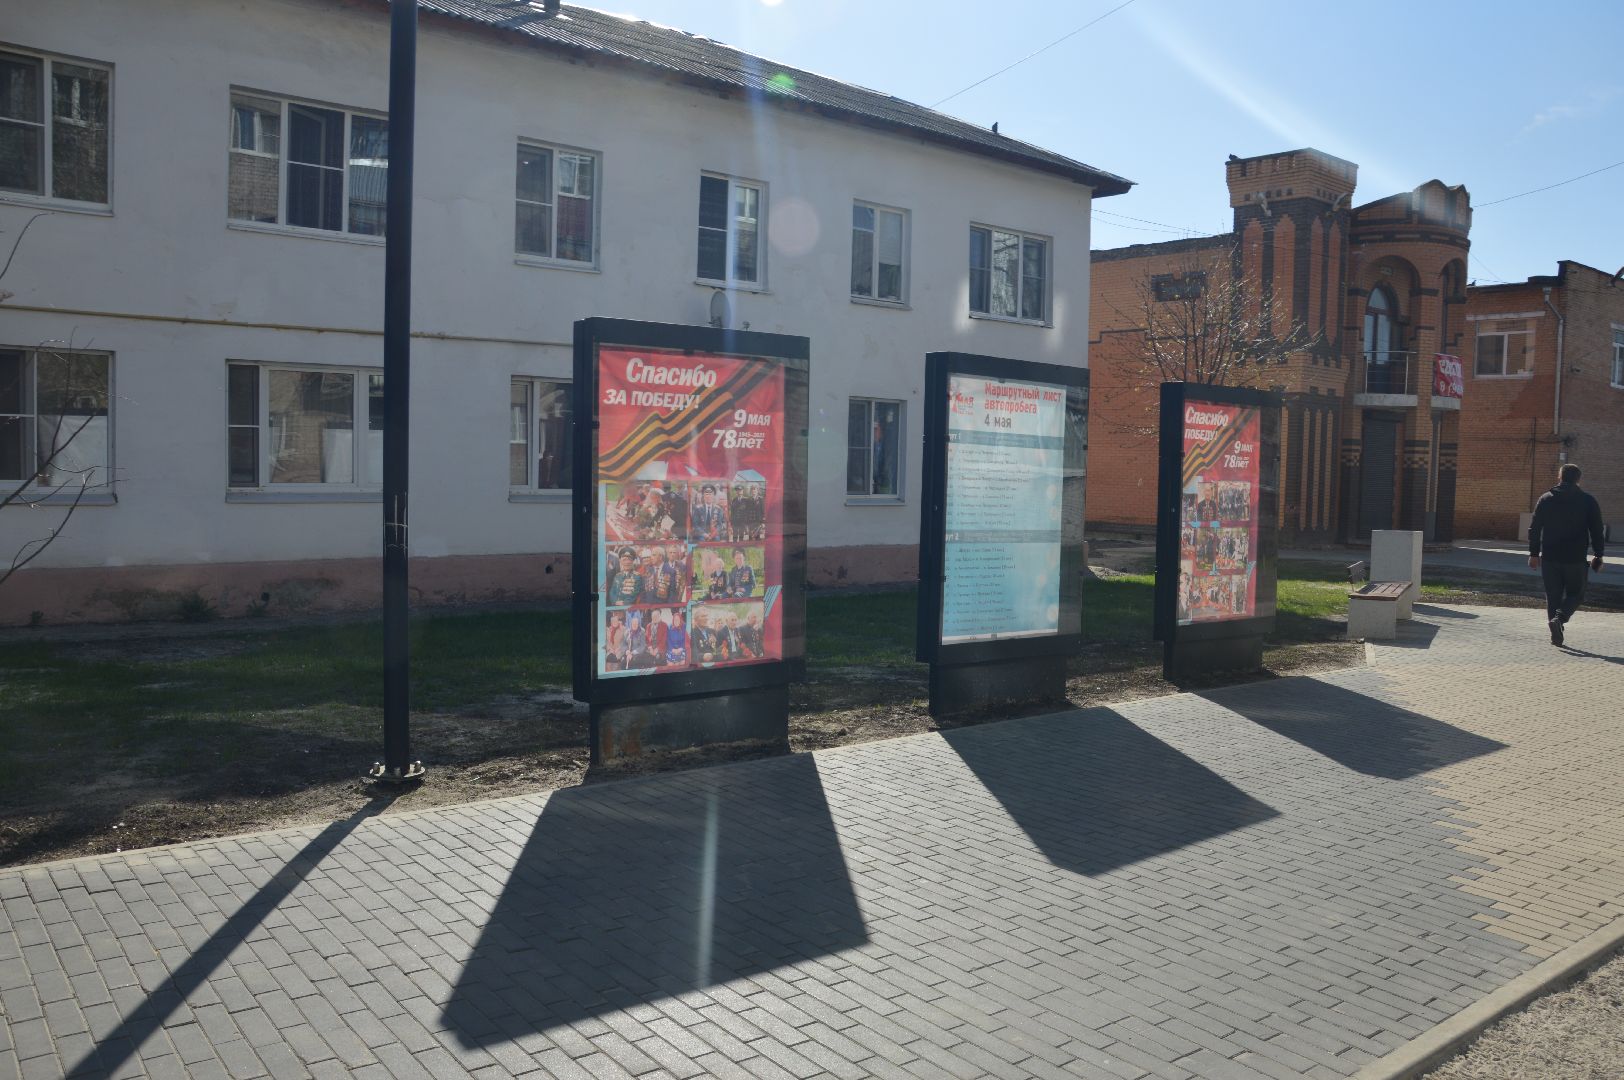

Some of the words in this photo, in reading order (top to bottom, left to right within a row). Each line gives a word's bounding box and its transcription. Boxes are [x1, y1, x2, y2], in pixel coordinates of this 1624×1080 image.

[626, 357, 717, 388] Спасибо
[603, 389, 627, 405] ЗА
[631, 390, 700, 411] ПОБЕДУ!
[984, 381, 1040, 400] Маршрутный
[1043, 390, 1062, 403] лист
[984, 399, 1037, 414] автопробега
[733, 408, 747, 428] 9
[747, 413, 771, 426] МАЯ
[984, 413, 990, 427] 4
[994, 416, 1012, 428] мая
[1186, 407, 1228, 426] Спасибо
[712, 429, 737, 449] 78
[736, 437, 765, 448] лет
[1184, 429, 1217, 441] ПОБЕДУ!
[1234, 440, 1241, 453] 9
[1224, 455, 1236, 467] 78
